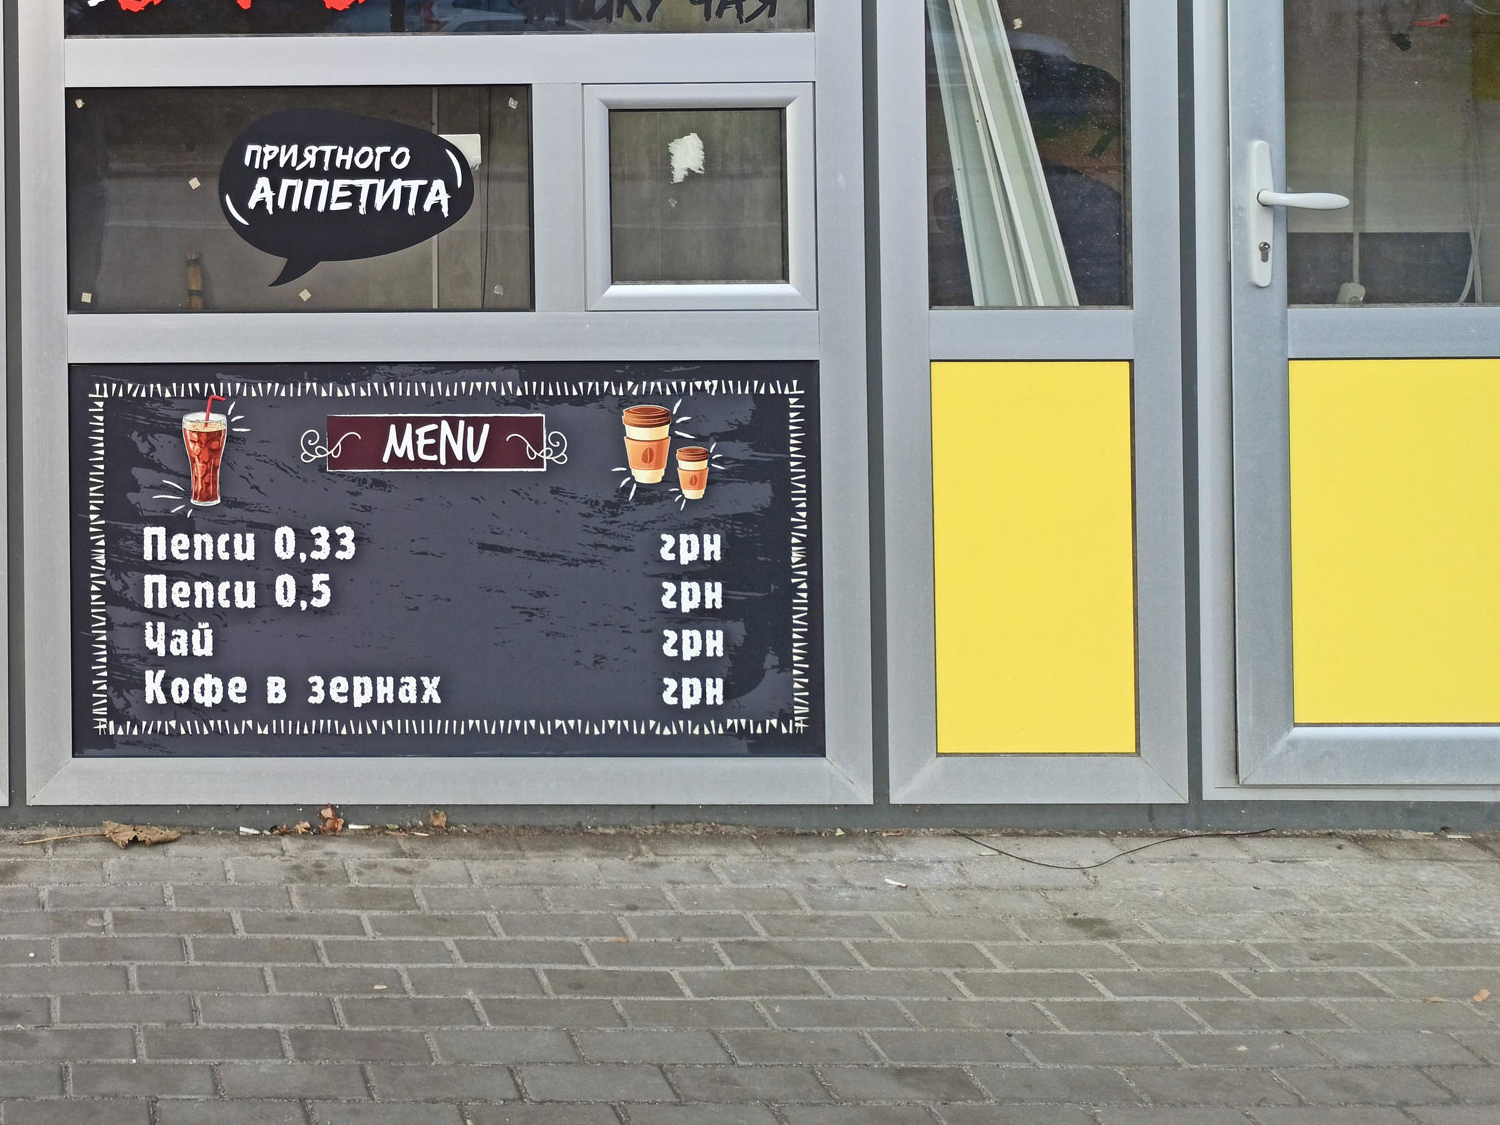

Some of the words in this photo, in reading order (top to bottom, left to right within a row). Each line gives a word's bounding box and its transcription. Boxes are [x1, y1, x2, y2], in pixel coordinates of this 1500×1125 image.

[245, 144, 410, 171] ПРИЯТНОГО
[247, 177, 450, 218] АППЕТИТА
[381, 420, 491, 464] MENU
[144, 527, 254, 561] Пепси
[275, 526, 355, 562] 0,33
[660, 534, 721, 564] грн
[144, 574, 255, 608] Пепси
[276, 574, 331, 610] 0,5
[662, 582, 722, 612] грн
[145, 622, 213, 656] Чай
[663, 630, 723, 660] грн
[145, 670, 247, 707] Кофе
[267, 677, 286, 703] в
[308, 676, 441, 707] зернах
[663, 678, 723, 709] грн
